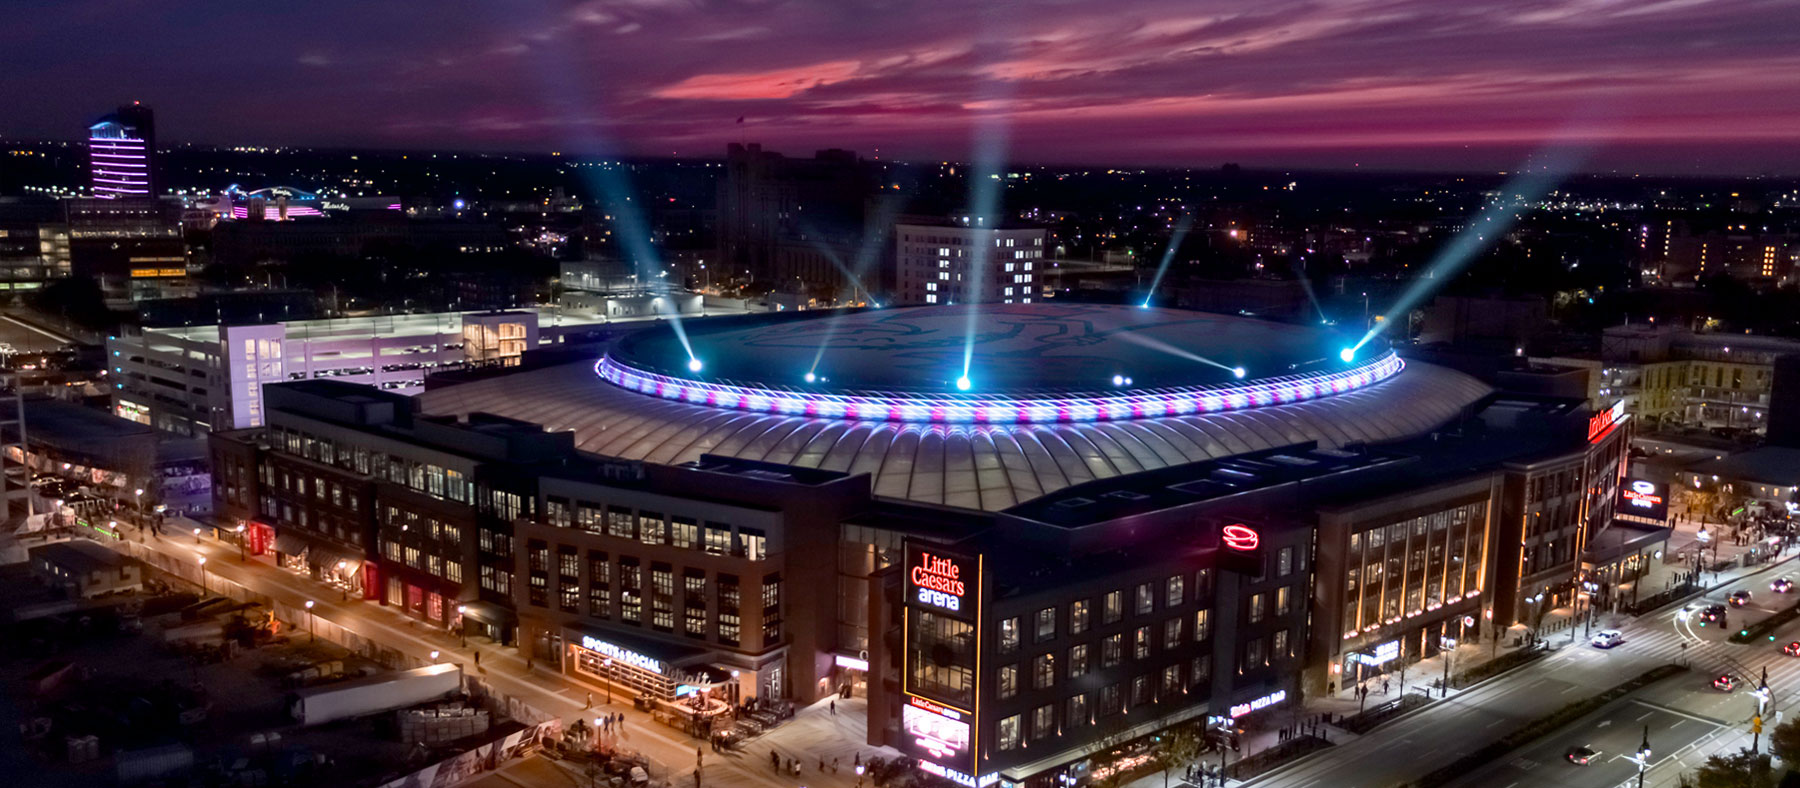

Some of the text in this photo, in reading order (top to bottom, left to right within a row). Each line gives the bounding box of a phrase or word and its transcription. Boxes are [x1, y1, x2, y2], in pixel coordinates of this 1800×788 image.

[922, 552, 959, 579] Little
[912, 565, 965, 597] Caesars
[918, 587, 959, 611] arena
[583, 635, 619, 659] SPORTS
[625, 650, 661, 674] SOCIAL
[661, 660, 711, 688] Detroit
[1250, 696, 1271, 711] PIZZA
[946, 768, 999, 788] PIZZA BAR
